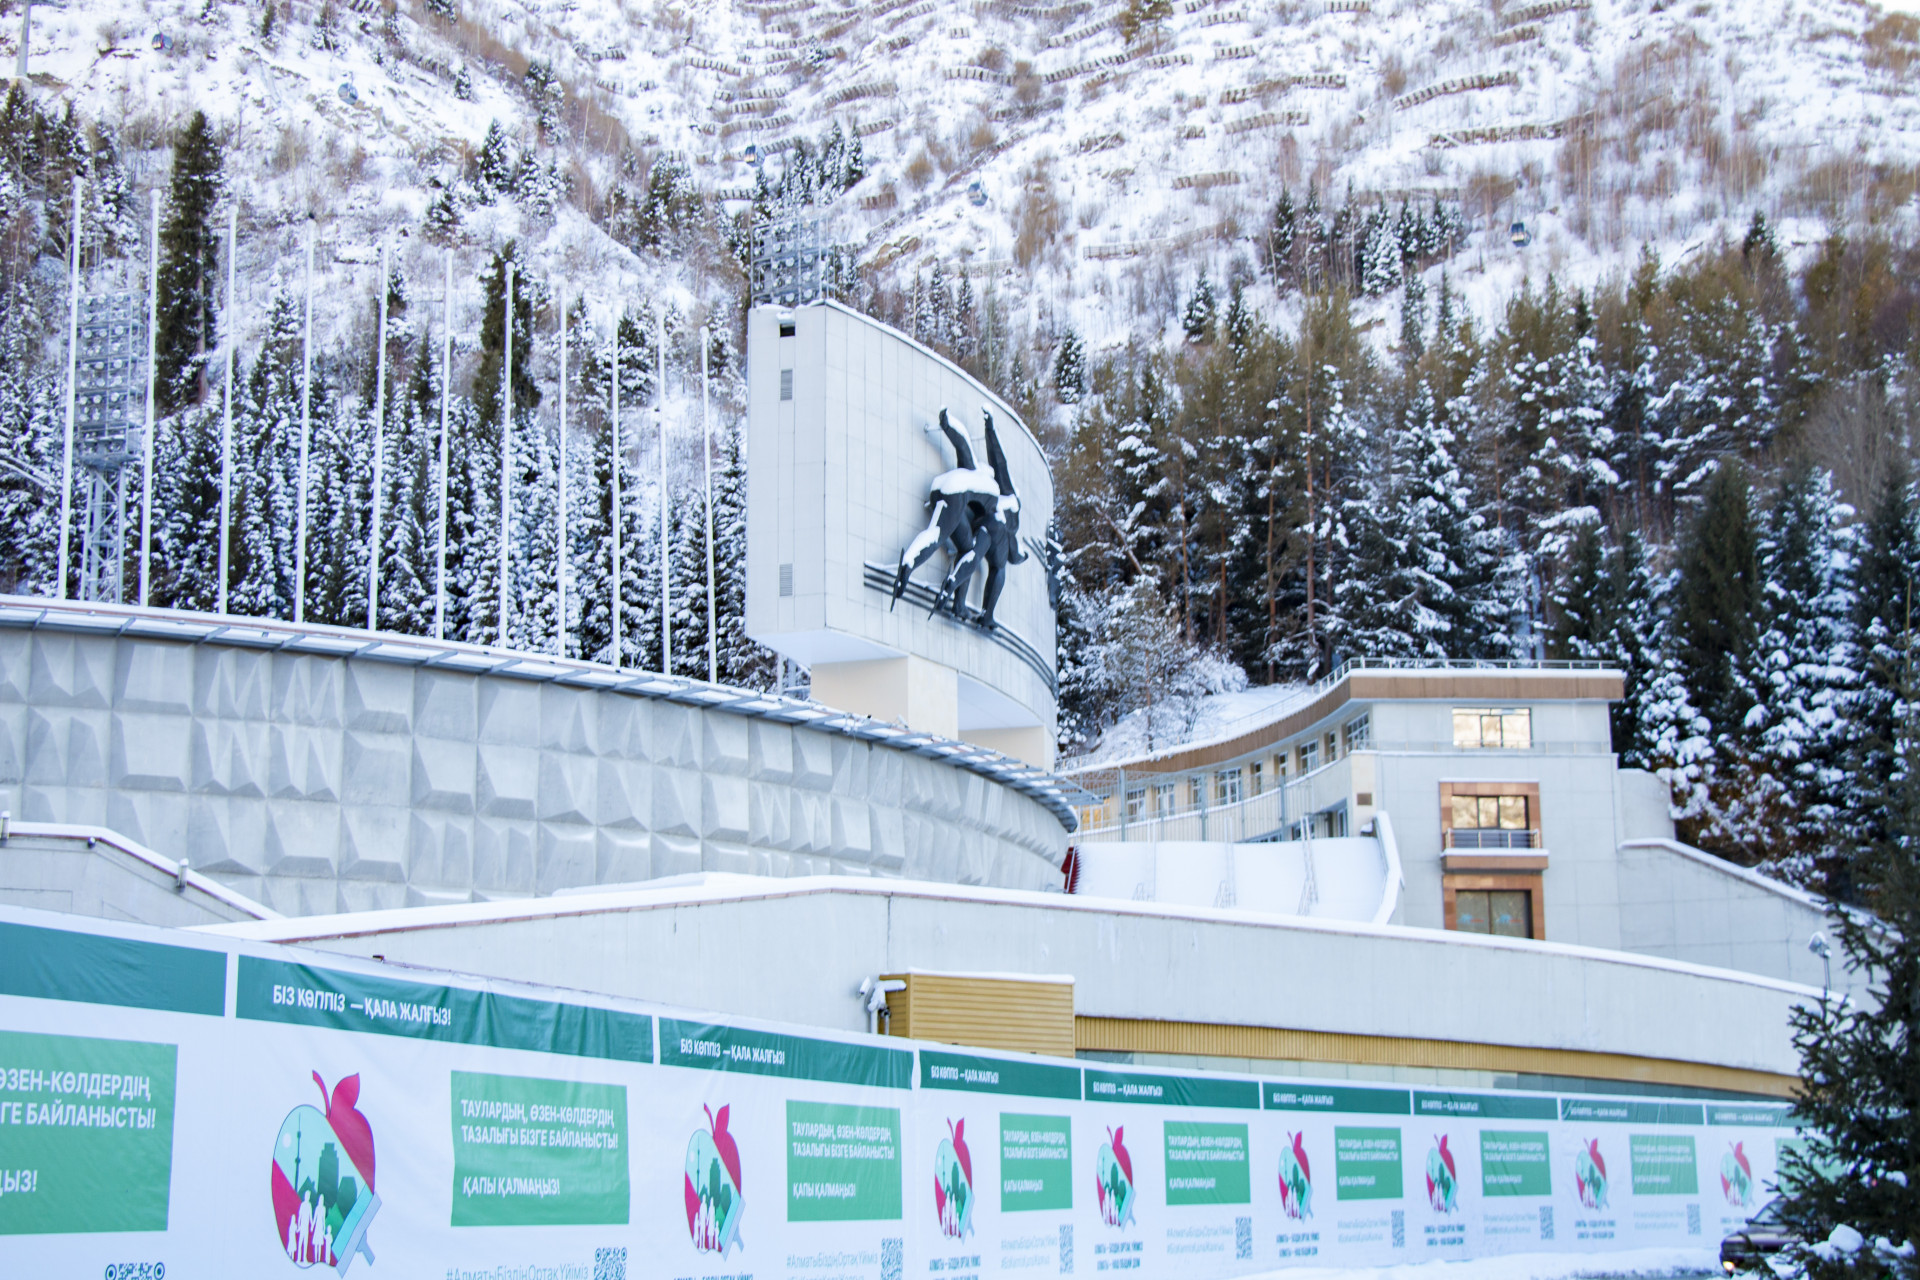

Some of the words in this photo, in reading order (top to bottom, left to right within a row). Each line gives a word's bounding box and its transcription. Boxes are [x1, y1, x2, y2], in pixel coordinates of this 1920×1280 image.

[273, 984, 295, 1005] БІЗ
[297, 988, 346, 1012] КӨППІЗ
[399, 1002, 451, 1026] ЖАЛҒЫЗ!
[680, 1038, 693, 1054] БІЗ
[26, 1099, 156, 1129] БАЙЛАНЫСТЫ!
[461, 1099, 528, 1124] ТАУЛАРДЫҢ,
[530, 1104, 615, 1129] ӨЗЕН-КӨЛДЕРДІҢ
[461, 1125, 518, 1145] ТАЗАЛЫҒЫ
[520, 1127, 547, 1146] БІЗГЕ
[549, 1127, 618, 1149] БАЙЛАНЫСТЫ!
[0, 1169, 38, 1197] ЫЗ!
[462, 1176, 496, 1198] ҚАПЫ
[497, 1177, 560, 1198] ҚАЛМАҢЫЗ!
